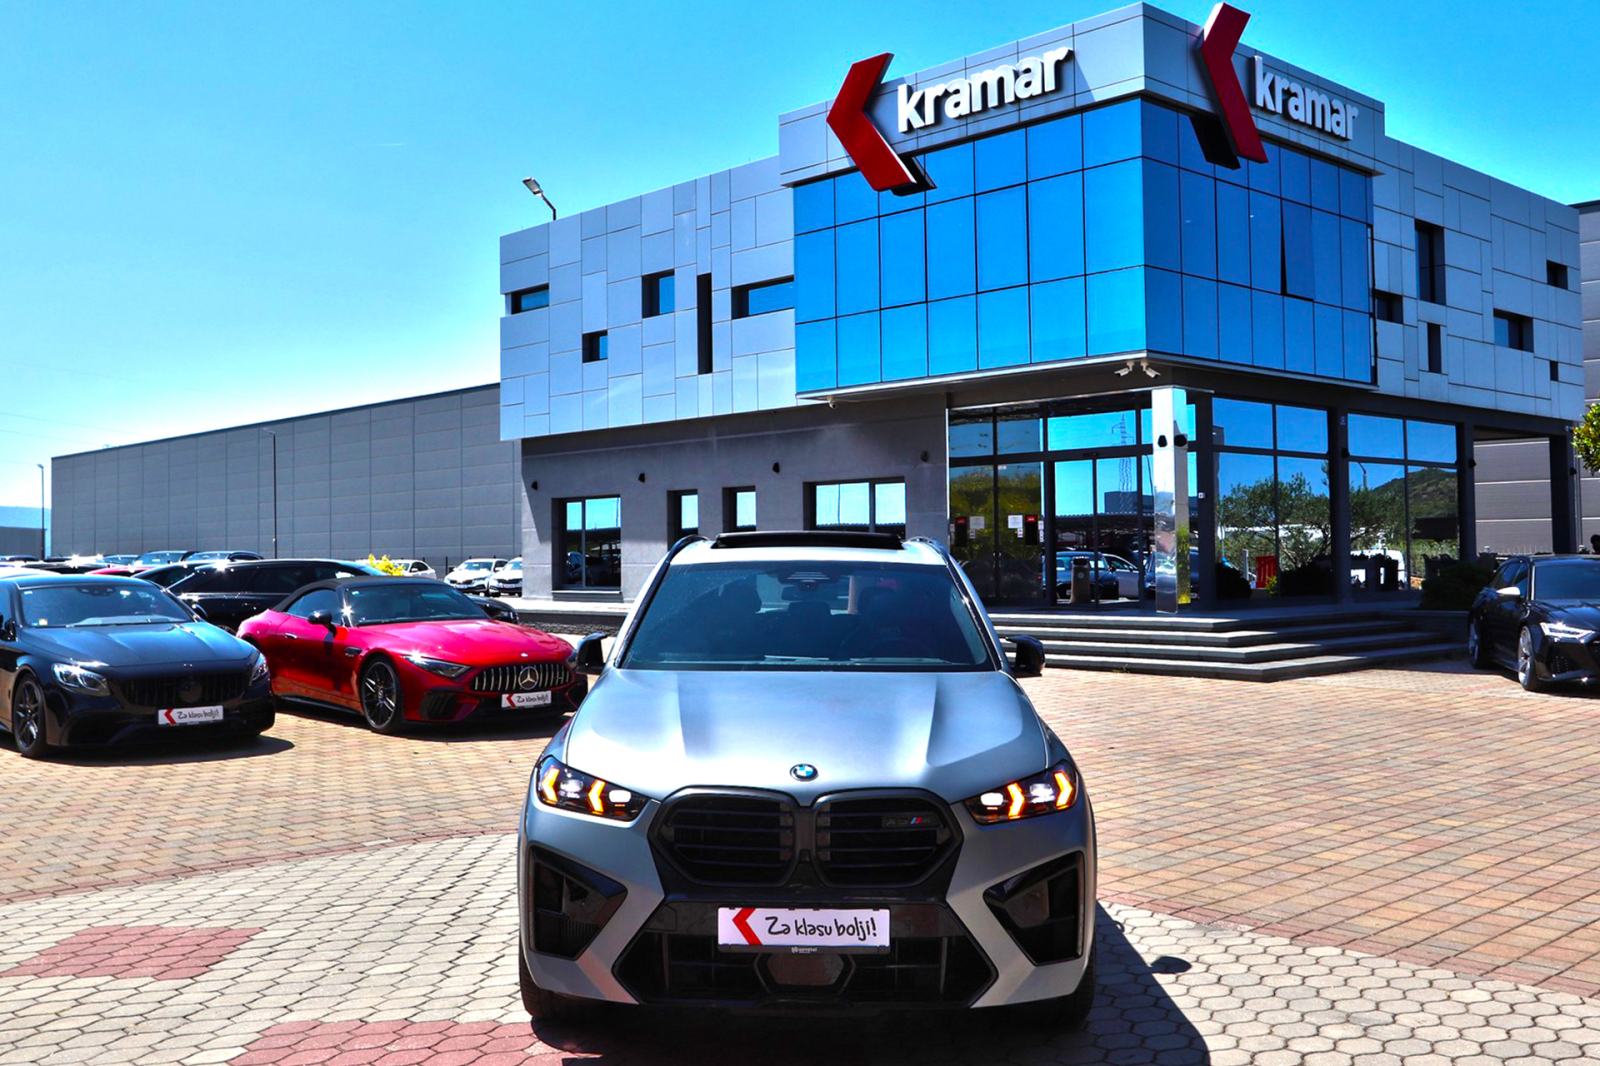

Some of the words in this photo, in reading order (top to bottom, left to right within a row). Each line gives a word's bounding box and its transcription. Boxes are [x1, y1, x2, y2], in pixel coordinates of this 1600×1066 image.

[897, 48, 1076, 134] kramar
[1254, 55, 1359, 140] kramar
[765, 916, 791, 935] Za
[794, 918, 833, 937] klasu
[834, 917, 877, 941] bolji!
